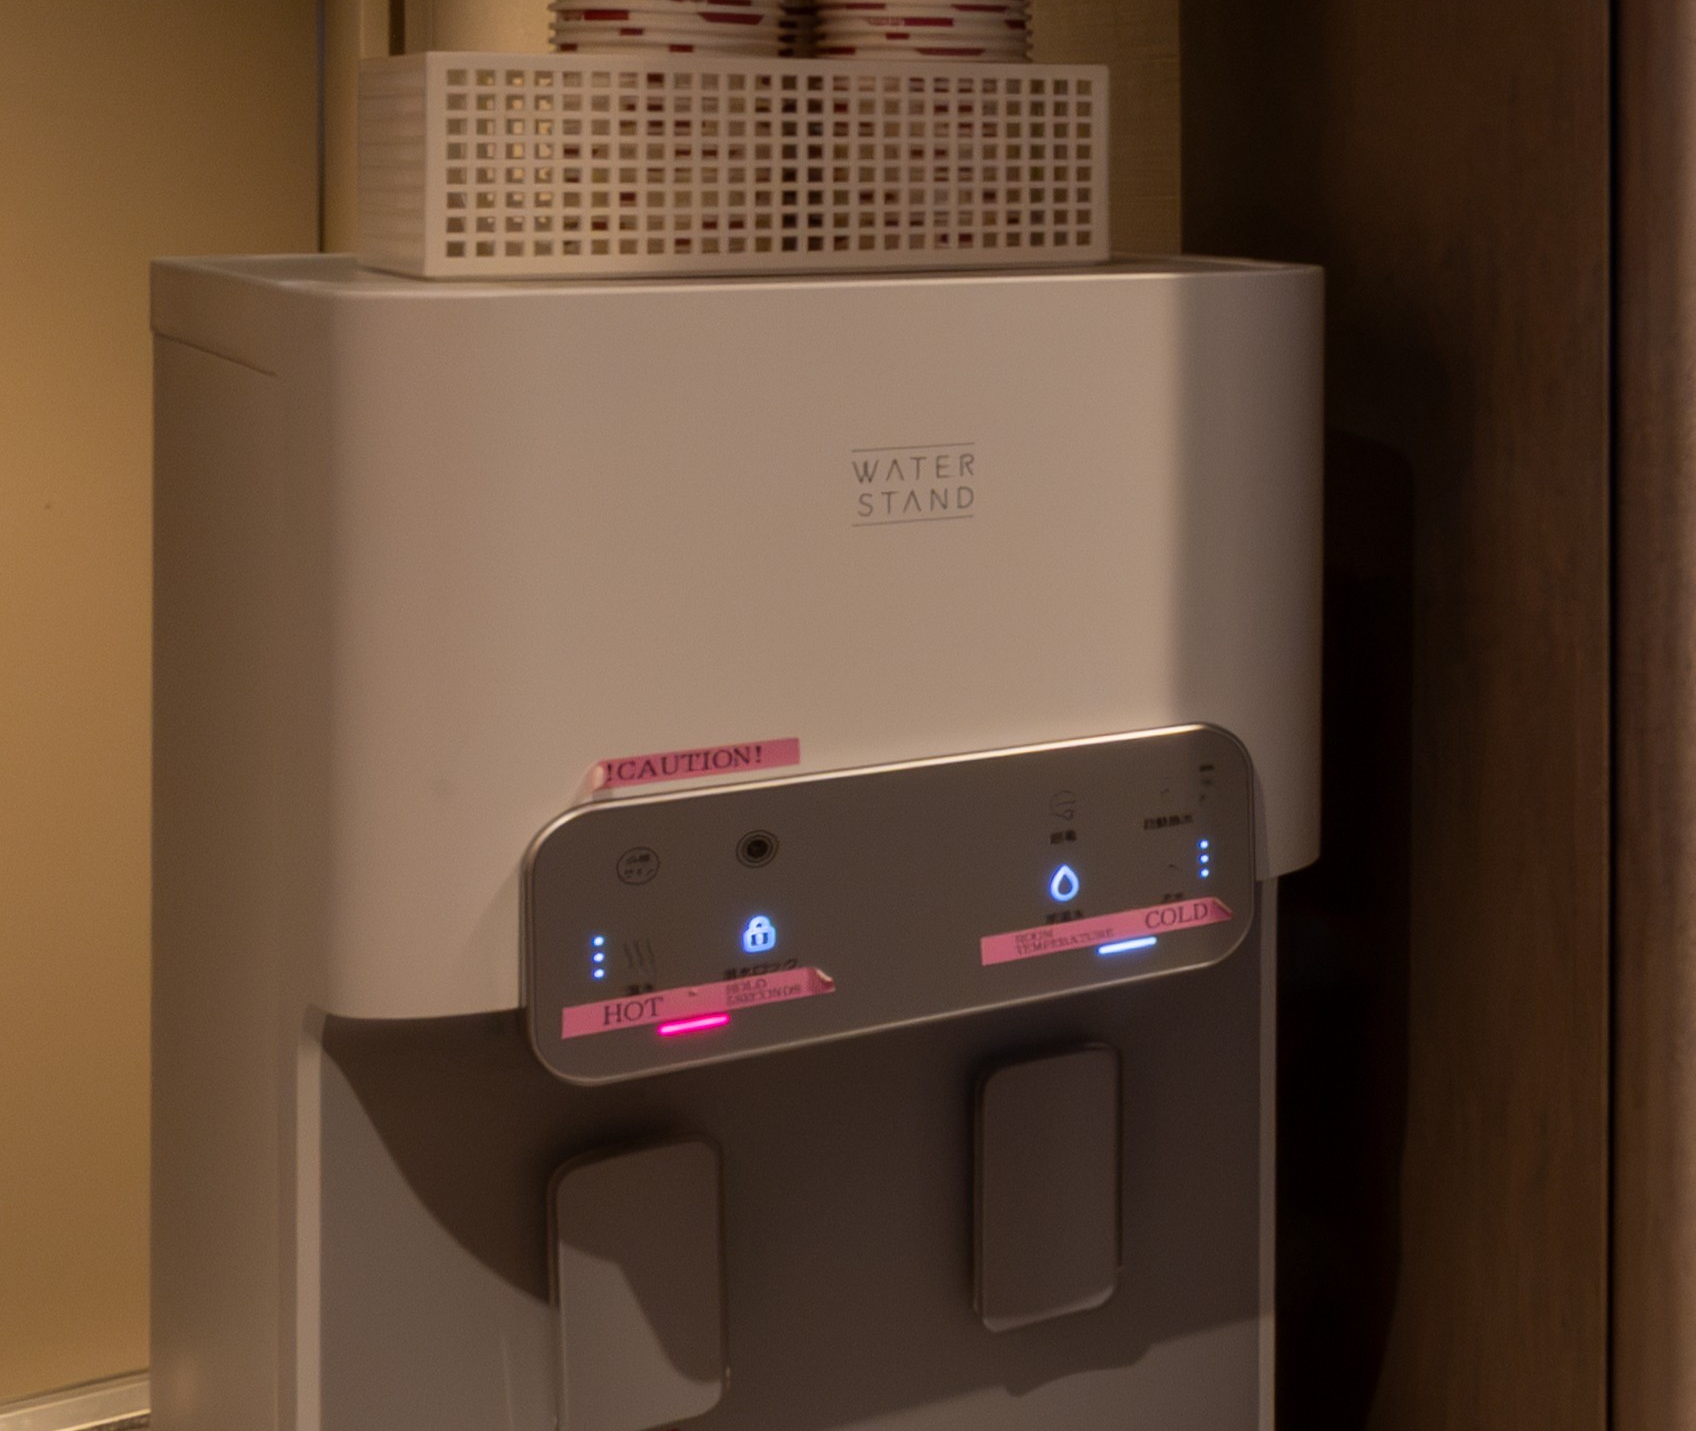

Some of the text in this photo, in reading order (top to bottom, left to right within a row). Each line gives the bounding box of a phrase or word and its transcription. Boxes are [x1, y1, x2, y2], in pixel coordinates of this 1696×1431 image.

[851, 452, 976, 485] WATER
[857, 485, 975, 518] STAND
[1145, 902, 1209, 930] COLD
[603, 996, 664, 1026] HOT
